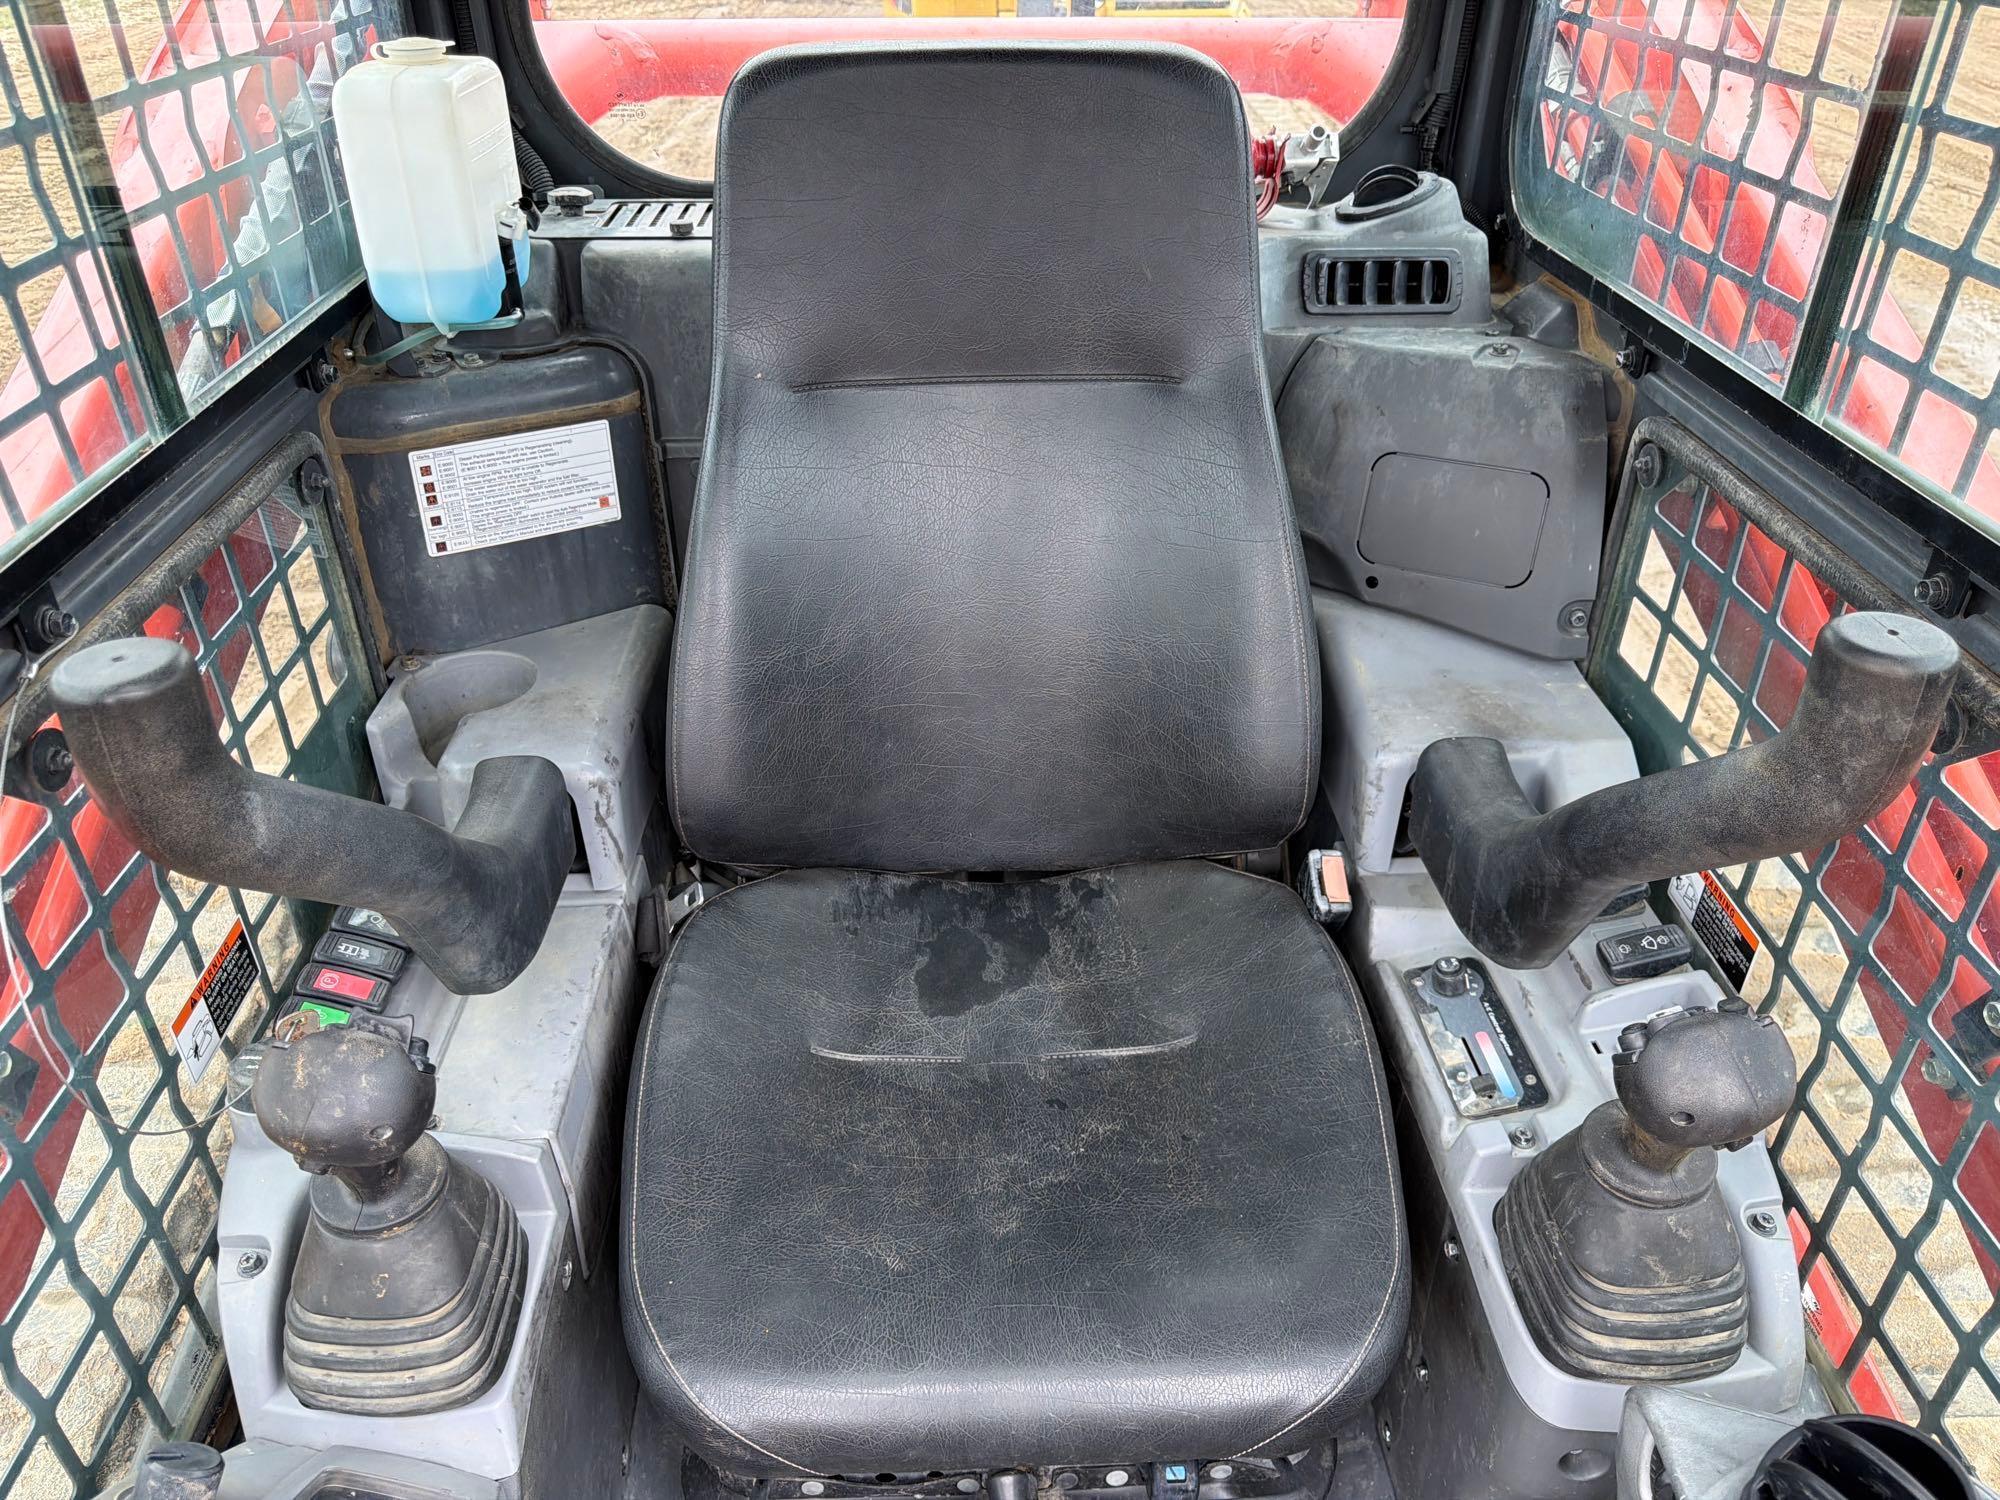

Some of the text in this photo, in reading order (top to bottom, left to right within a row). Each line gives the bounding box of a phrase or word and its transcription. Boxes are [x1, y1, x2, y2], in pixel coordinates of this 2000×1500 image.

[1702, 873, 1735, 918] WARNING
[196, 941, 230, 997] WARNING
[205, 937, 241, 999] TO AVOID PERSONAL
[207, 981, 222, 1006] INJURY
[221, 971, 228, 984] OR
[1488, 1012, 1503, 1033] Control
